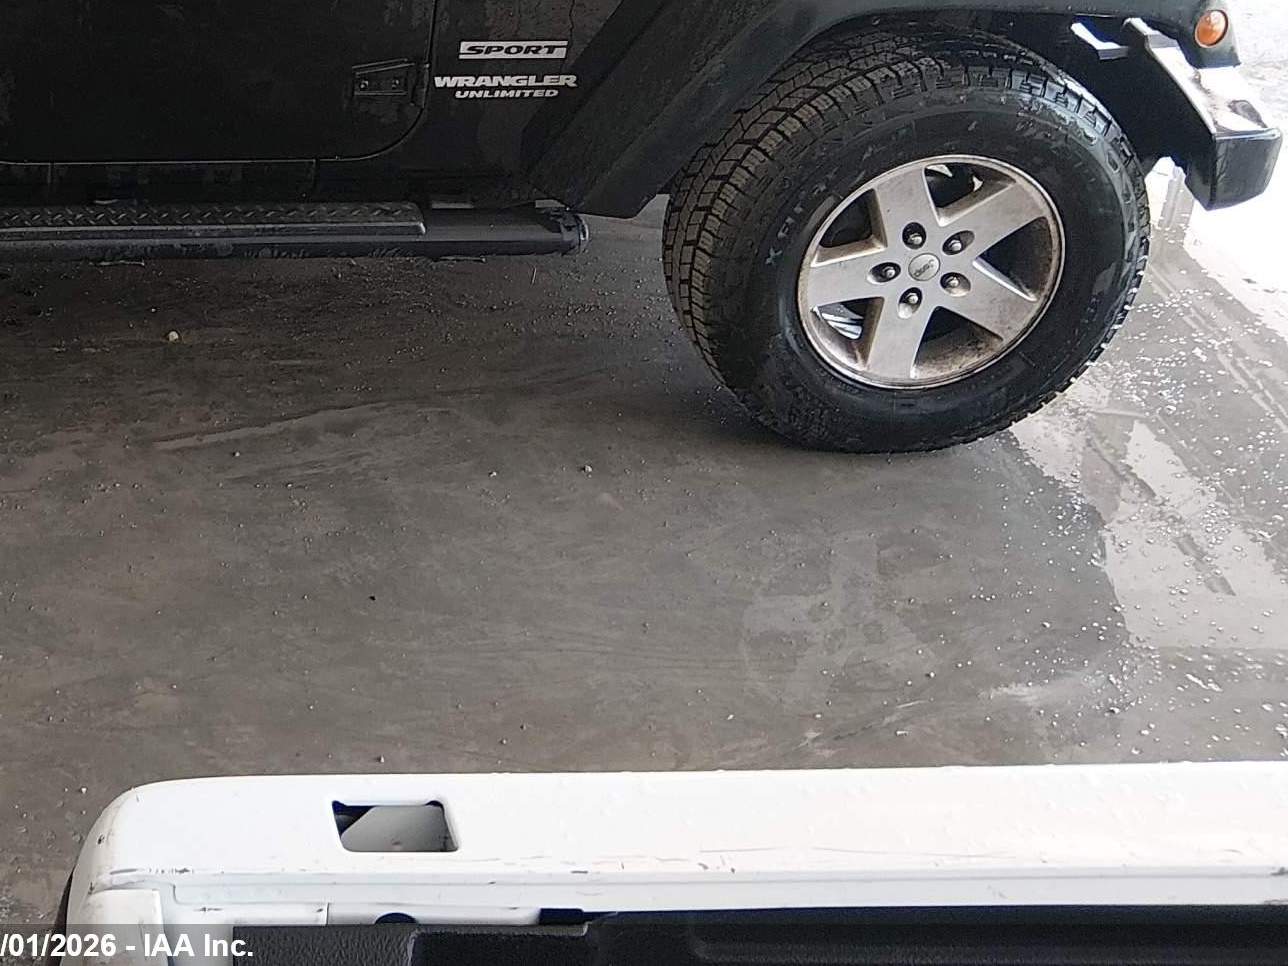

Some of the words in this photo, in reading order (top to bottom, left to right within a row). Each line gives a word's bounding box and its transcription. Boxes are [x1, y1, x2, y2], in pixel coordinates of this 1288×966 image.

[462, 43, 568, 56] SPORT
[434, 75, 578, 87] WRANGLER
[455, 89, 559, 99] UNLIMITED
